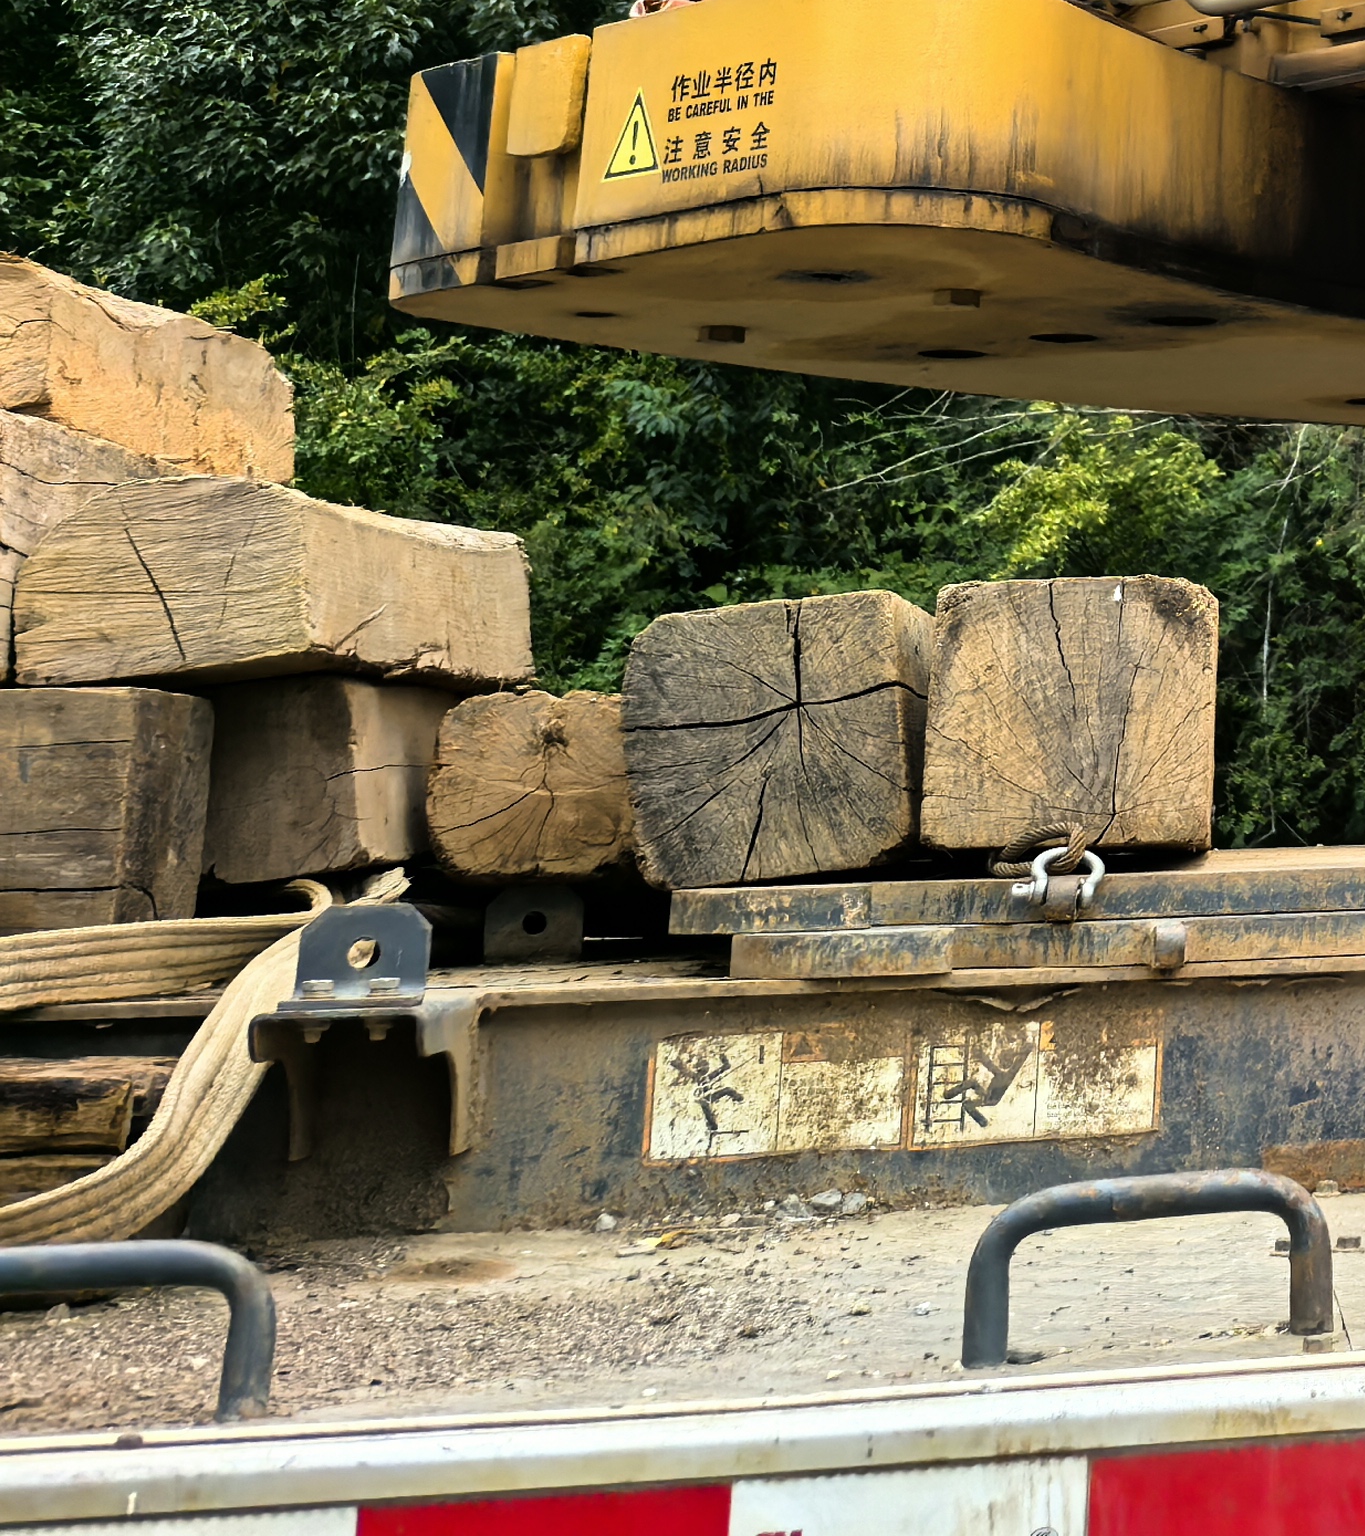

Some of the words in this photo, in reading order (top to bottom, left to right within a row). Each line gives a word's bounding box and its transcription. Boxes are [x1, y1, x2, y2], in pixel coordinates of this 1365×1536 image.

[671, 58, 777, 102] 作业半径内
[668, 107, 682, 122] BE
[686, 98, 732, 119] CAREFUL
[737, 95, 749, 110] IN
[753, 90, 774, 106] THE
[663, 121, 770, 164] 注意安全
[662, 161, 718, 183] WORKING
[723, 154, 768, 174] RADIUS
